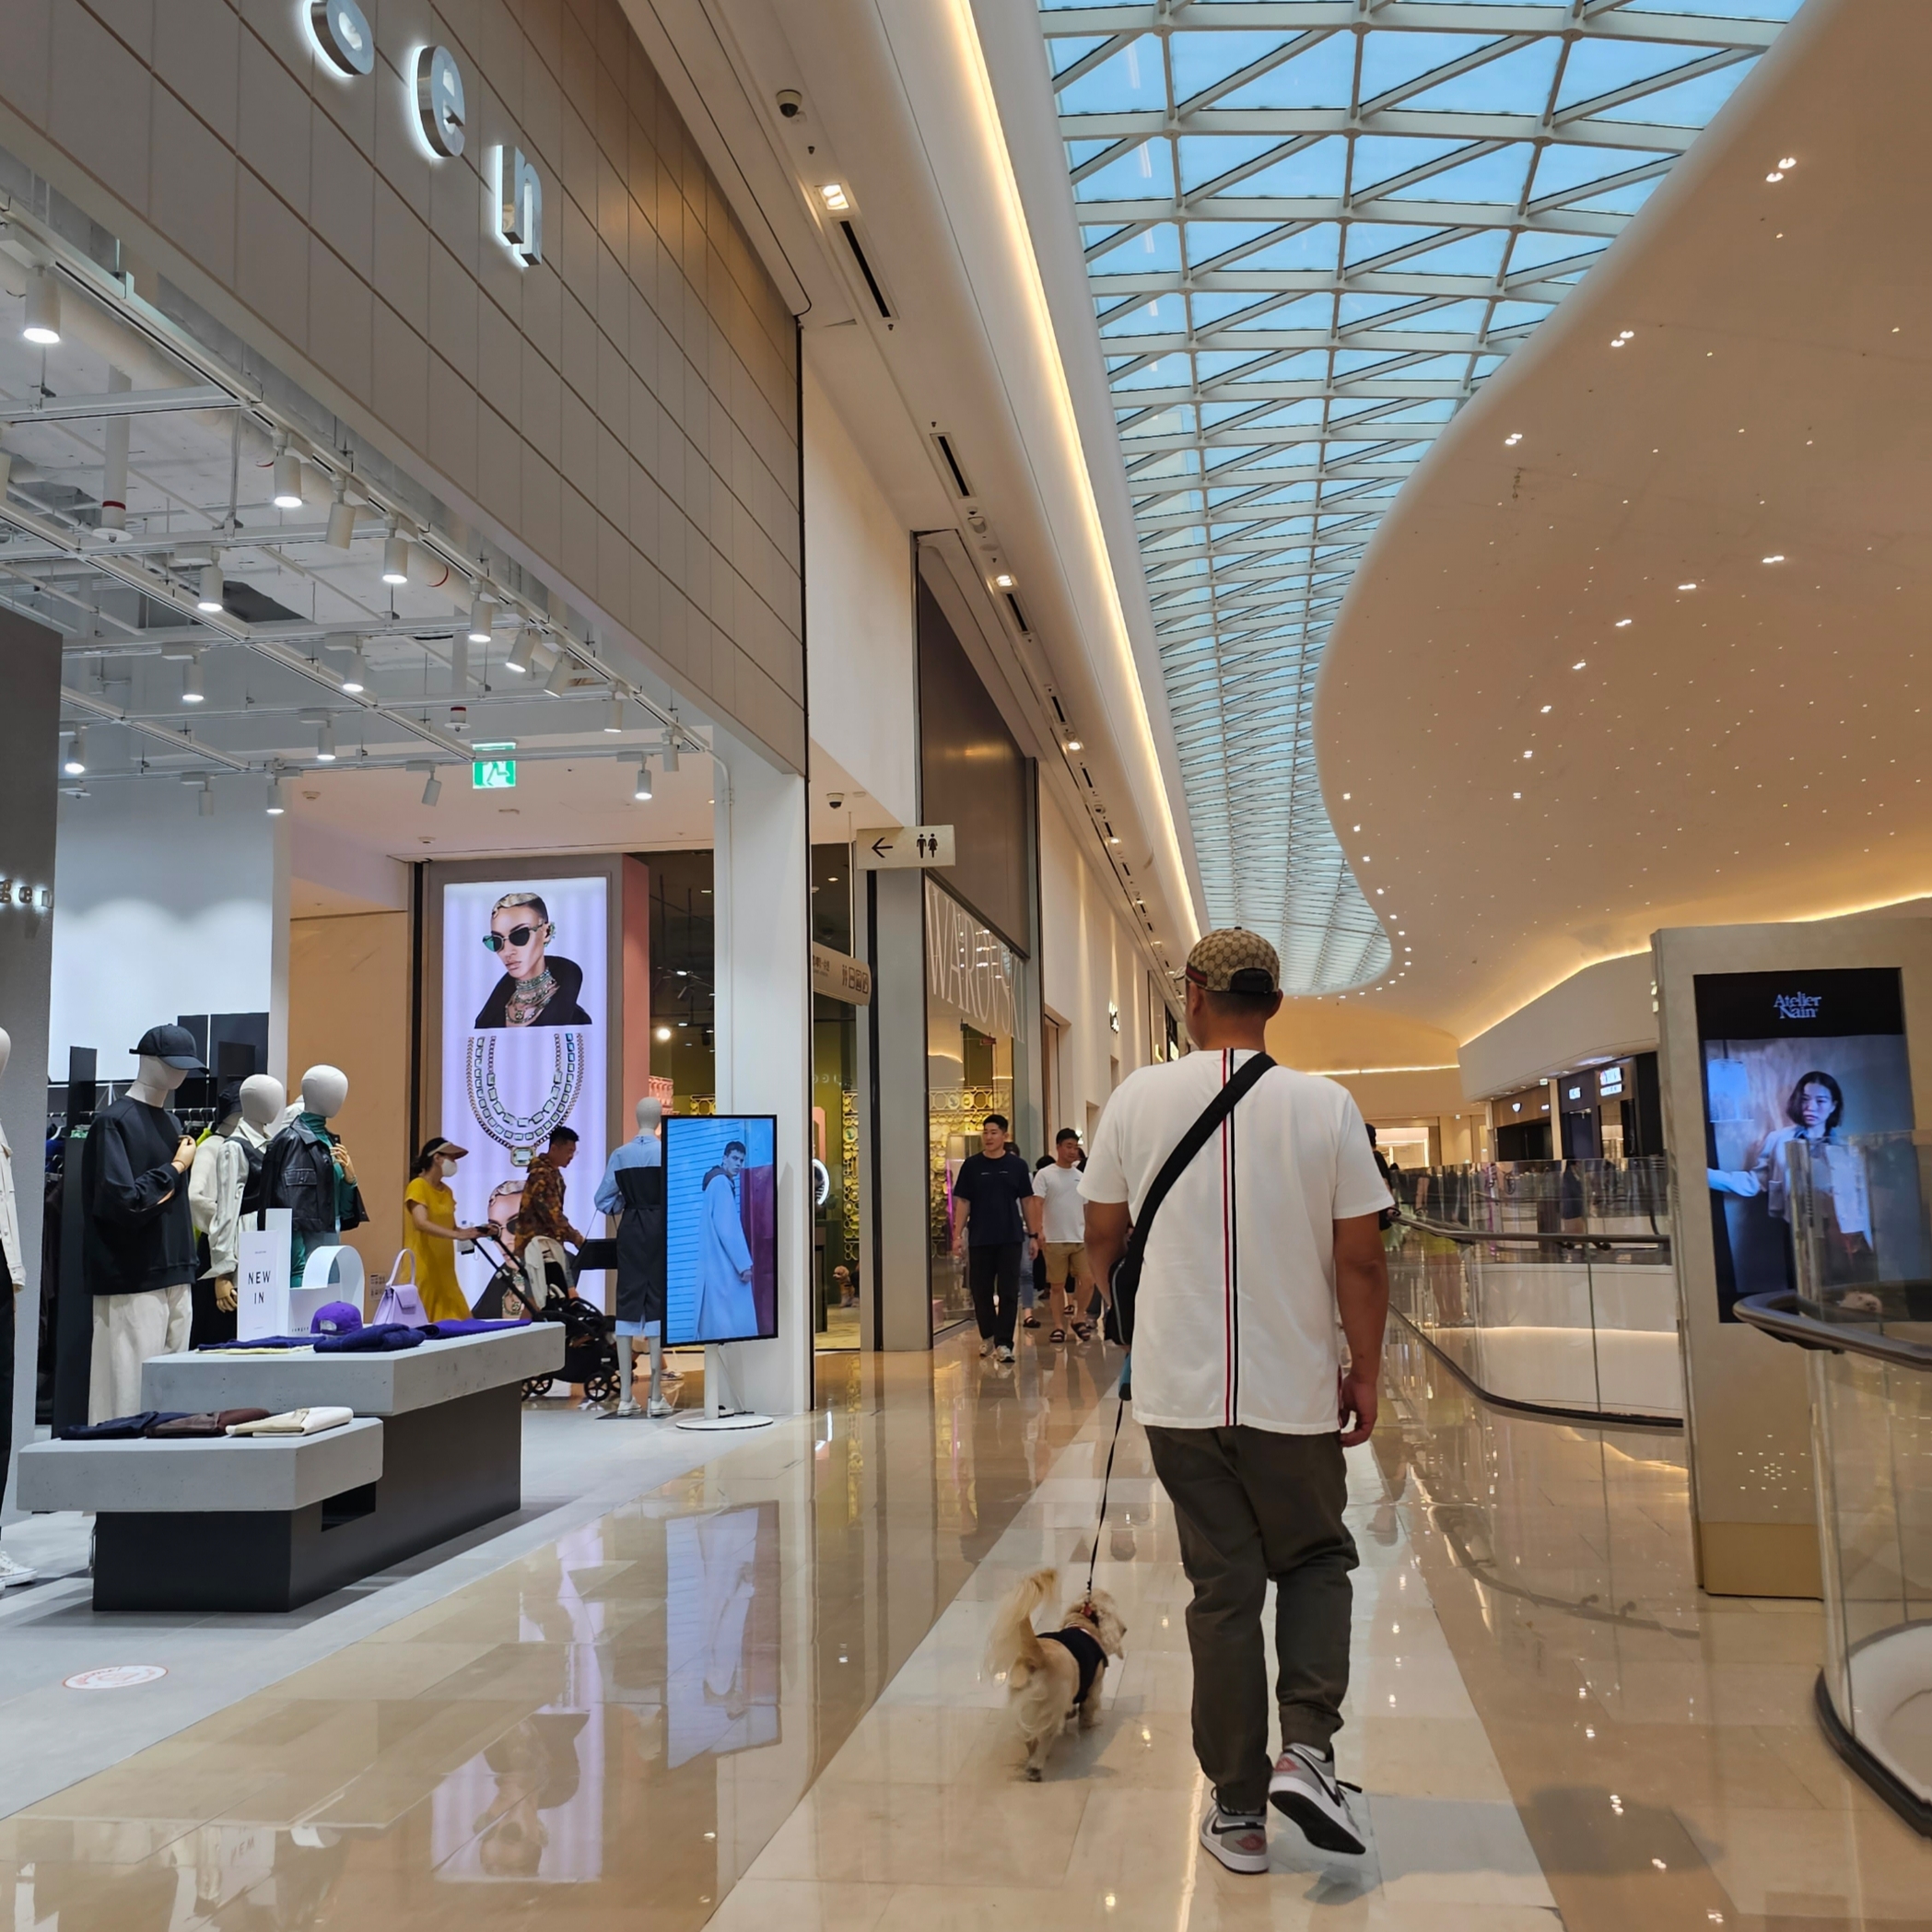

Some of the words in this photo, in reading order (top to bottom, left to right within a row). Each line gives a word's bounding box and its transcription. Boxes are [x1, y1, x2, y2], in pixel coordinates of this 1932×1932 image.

[1774, 991, 1822, 1008] Atelier
[248, 1270, 271, 1285] NEW
[253, 1292, 264, 1305] IN
